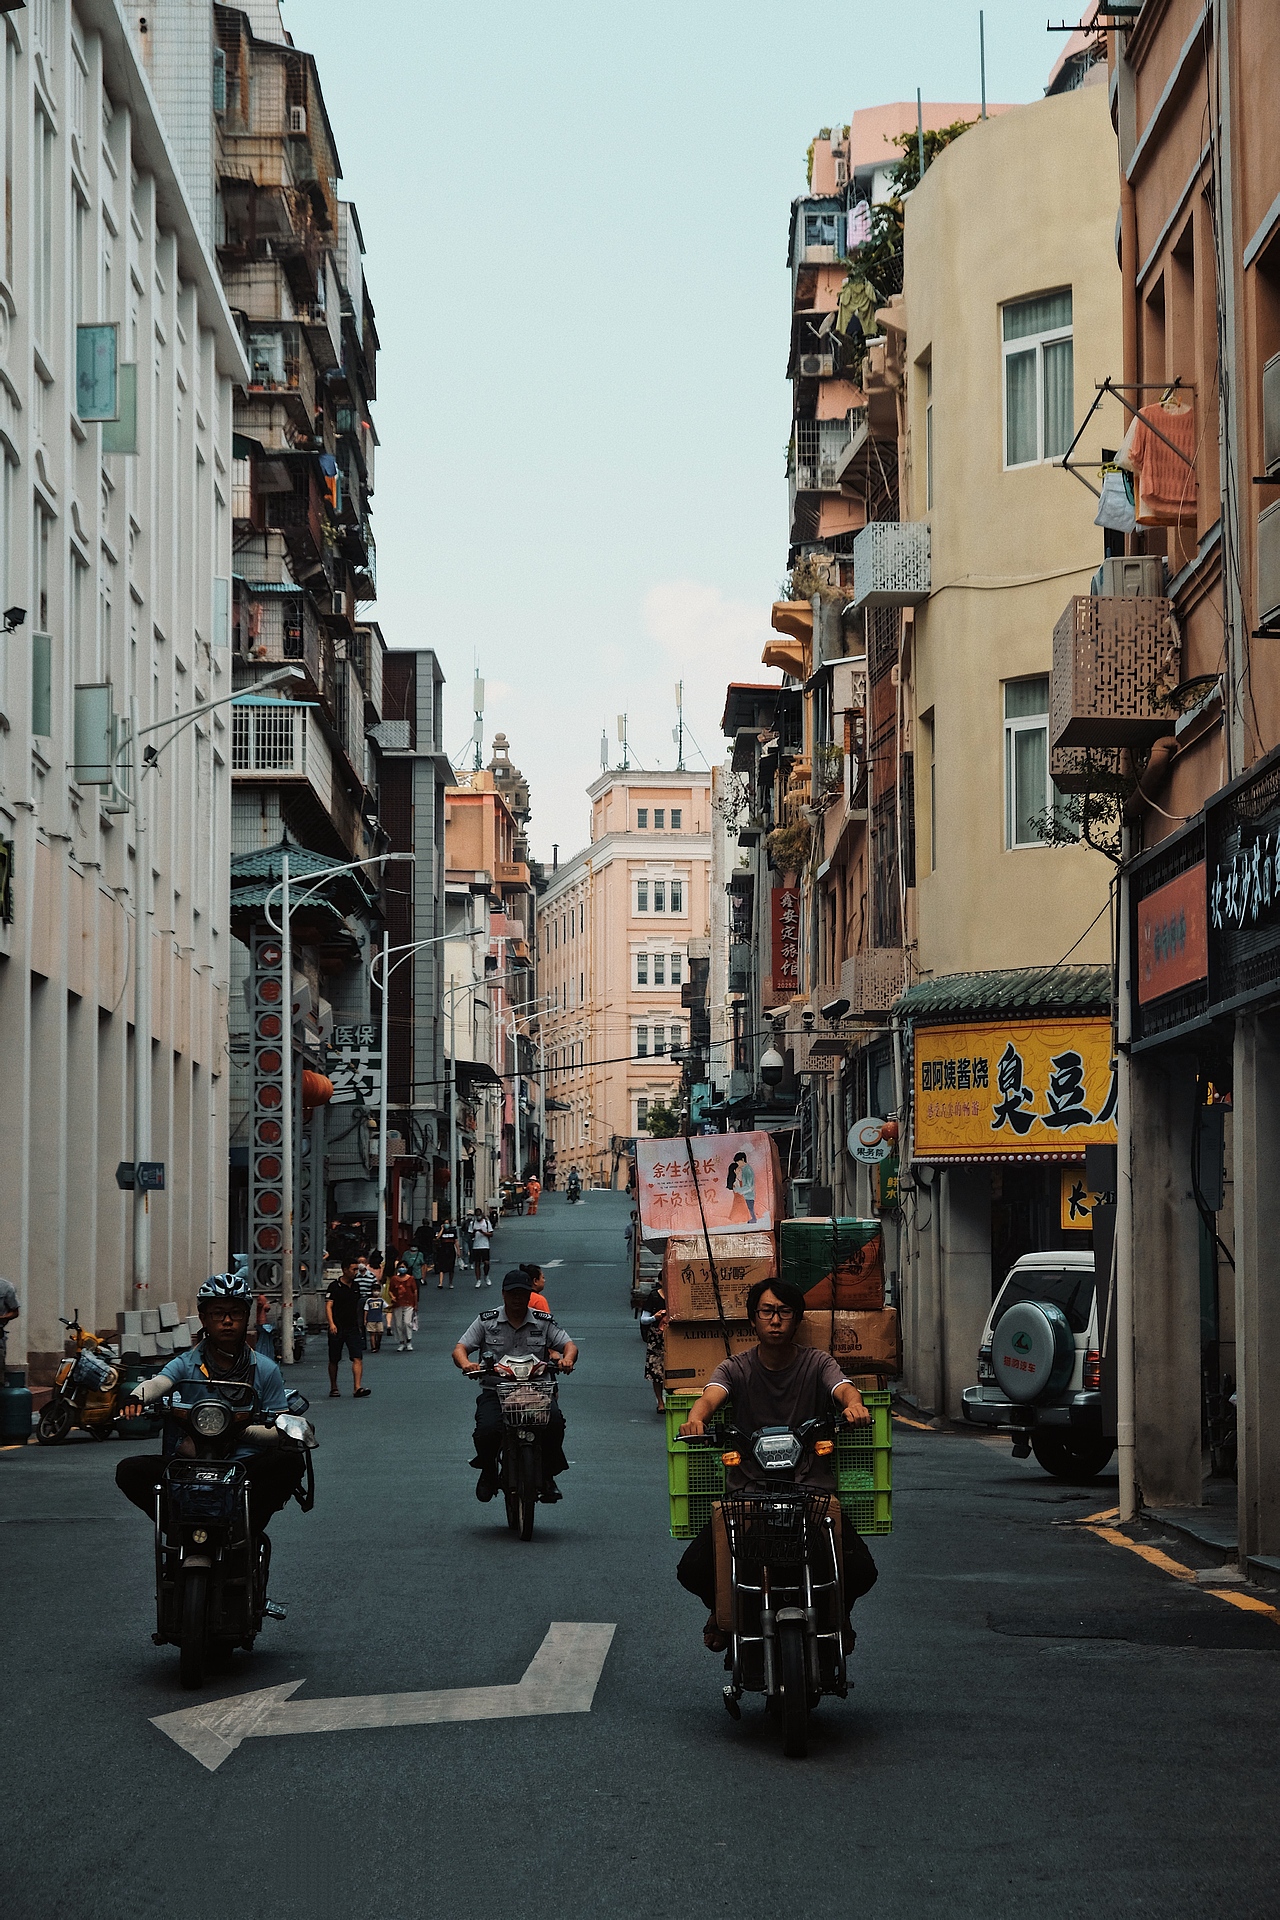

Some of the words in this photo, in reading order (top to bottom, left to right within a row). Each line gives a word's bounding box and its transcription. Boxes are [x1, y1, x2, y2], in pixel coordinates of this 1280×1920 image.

[779, 891, 799, 976] 鑫安定旅馆
[335, 1025, 375, 1046] 医保
[326, 1046, 382, 1105] 药
[921, 1057, 989, 1092] 团阿姨酱烧
[857, 1147, 885, 1158] 果务院
[652, 1158, 716, 1178] 余生很长
[653, 1188, 719, 1208] 不负遇见
[683, 1329, 720, 1340] PURITY
